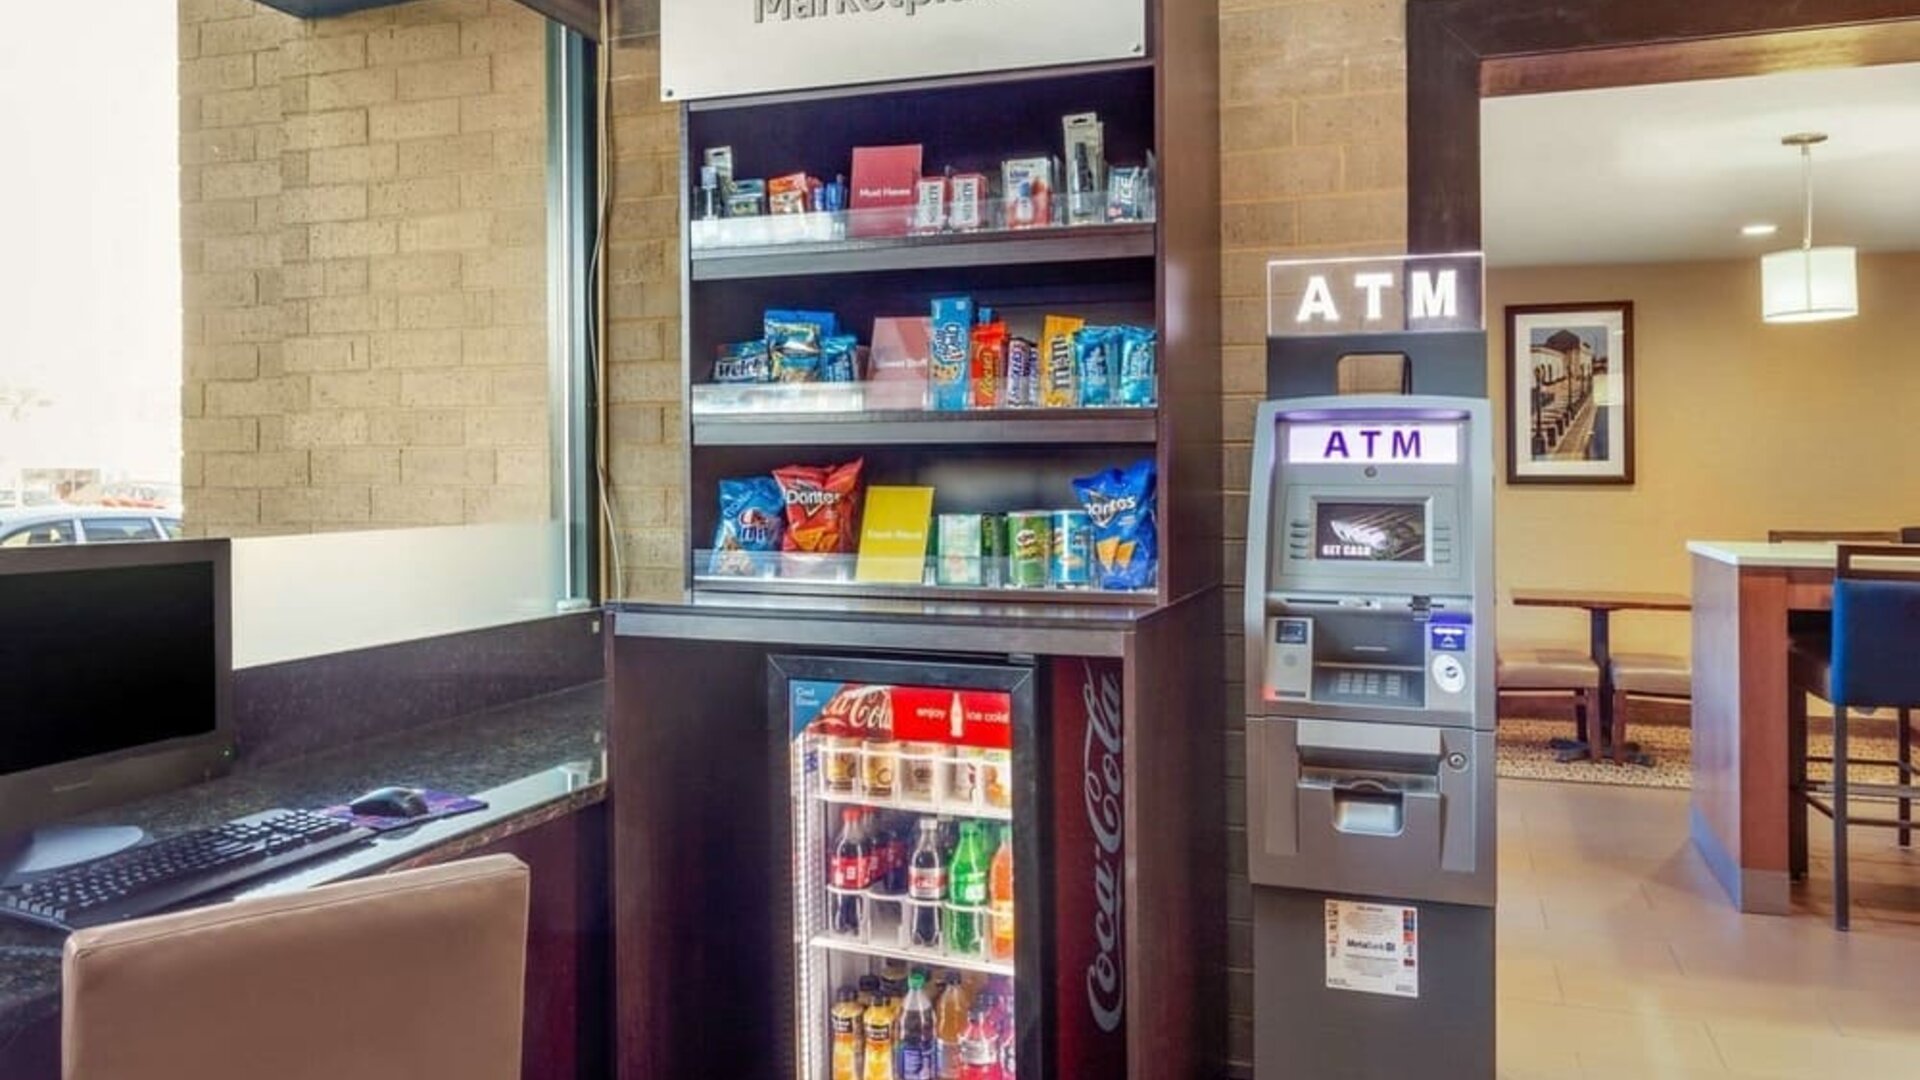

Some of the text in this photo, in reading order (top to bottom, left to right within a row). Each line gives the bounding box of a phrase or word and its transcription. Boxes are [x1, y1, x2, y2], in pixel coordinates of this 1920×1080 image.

[1296, 269, 1457, 322] ATM
[1324, 430, 1421, 458] ATM
[1322, 544, 1341, 556] GET
[916, 707, 947, 720] enjoy
[1083, 658, 1124, 1033] Coca-Cola
